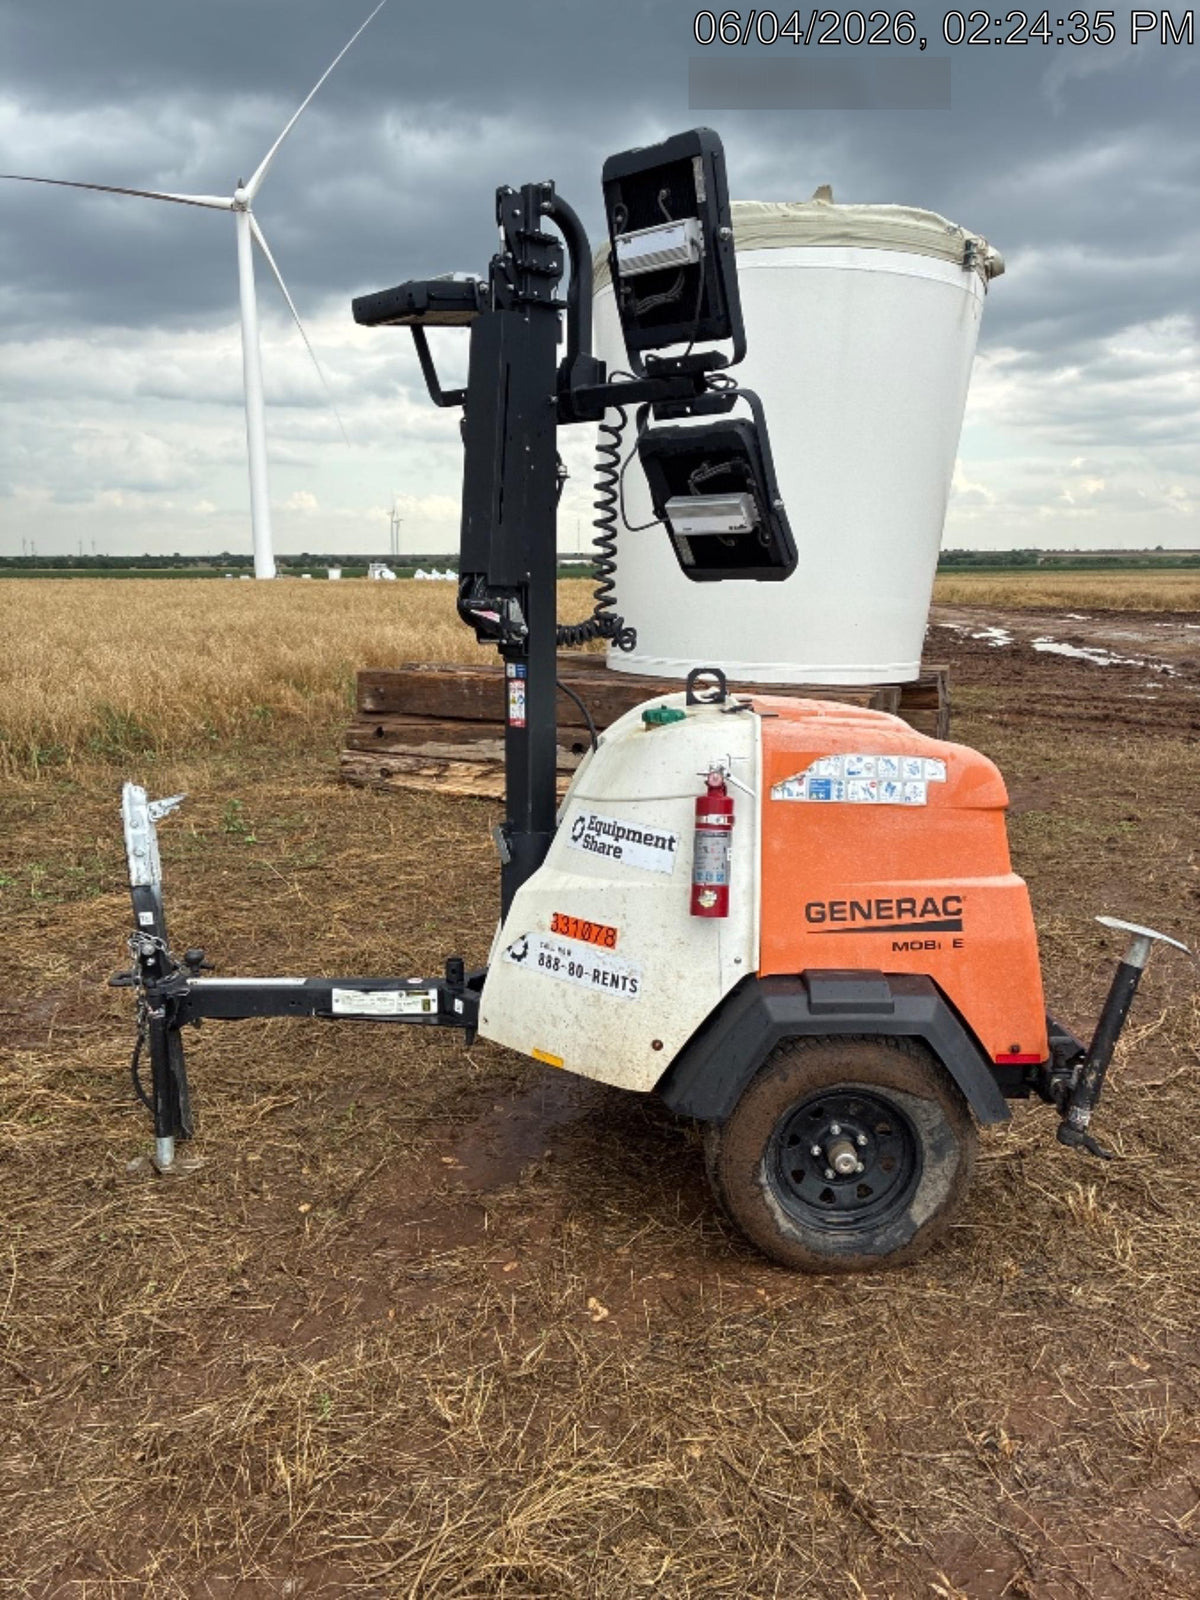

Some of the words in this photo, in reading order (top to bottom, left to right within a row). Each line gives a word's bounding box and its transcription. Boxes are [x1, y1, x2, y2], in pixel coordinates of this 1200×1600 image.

[582, 834, 624, 860] Share
[587, 815, 677, 852] Equipment
[804, 895, 963, 923] GENERAC
[550, 912, 617, 948] 331078
[892, 938, 964, 952] MOBIE
[538, 952, 639, 994] 888-80-RENTS
